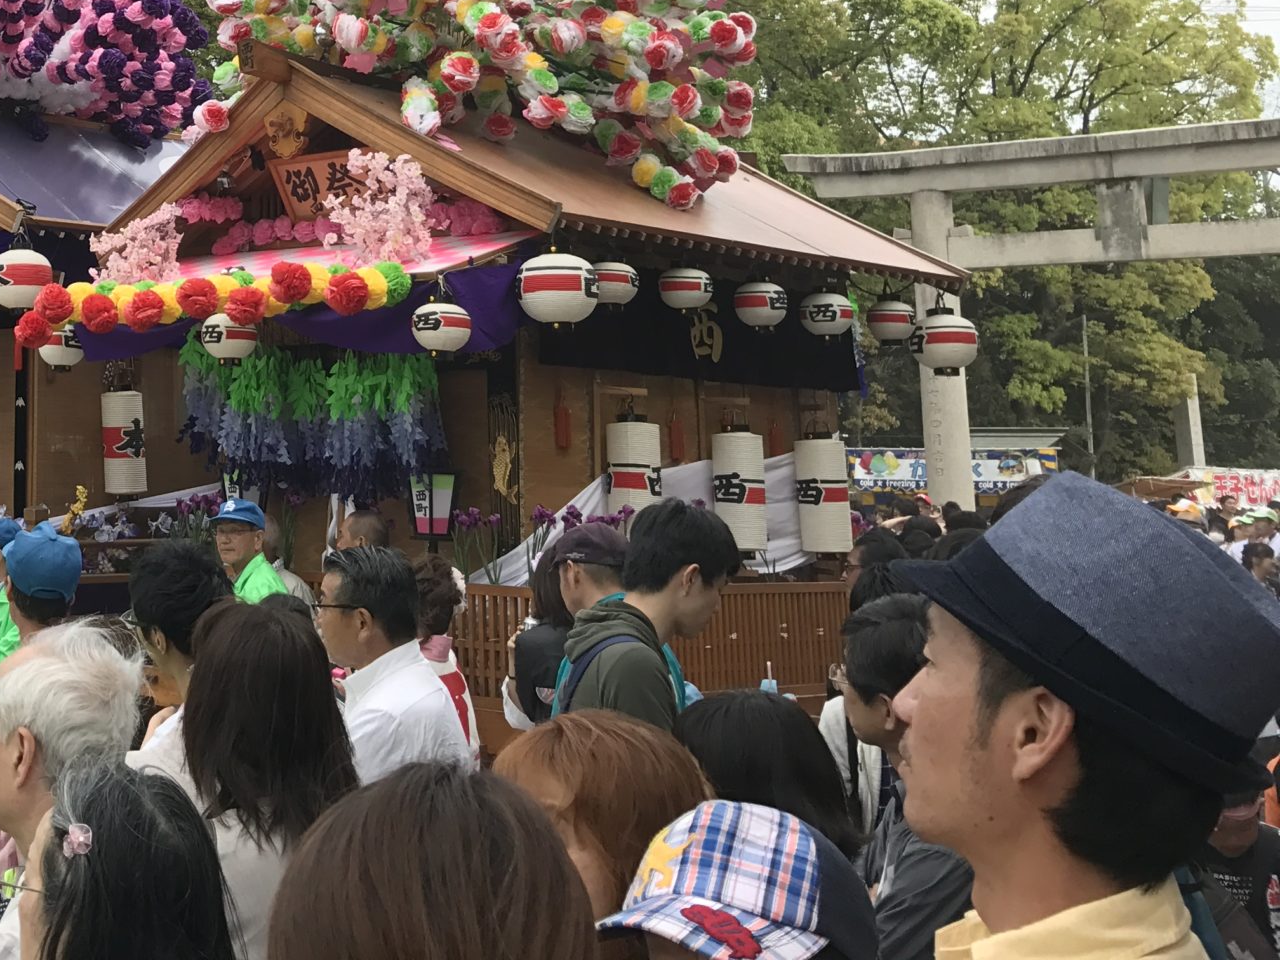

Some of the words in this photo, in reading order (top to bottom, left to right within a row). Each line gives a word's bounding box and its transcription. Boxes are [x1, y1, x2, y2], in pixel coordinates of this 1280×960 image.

[414, 310, 443, 332] 西
[807, 303, 838, 323] 西
[202, 324, 224, 344] 西
[713, 472, 748, 505] 西
[796, 477, 823, 506] 西
[415, 489, 429, 517] 西町
